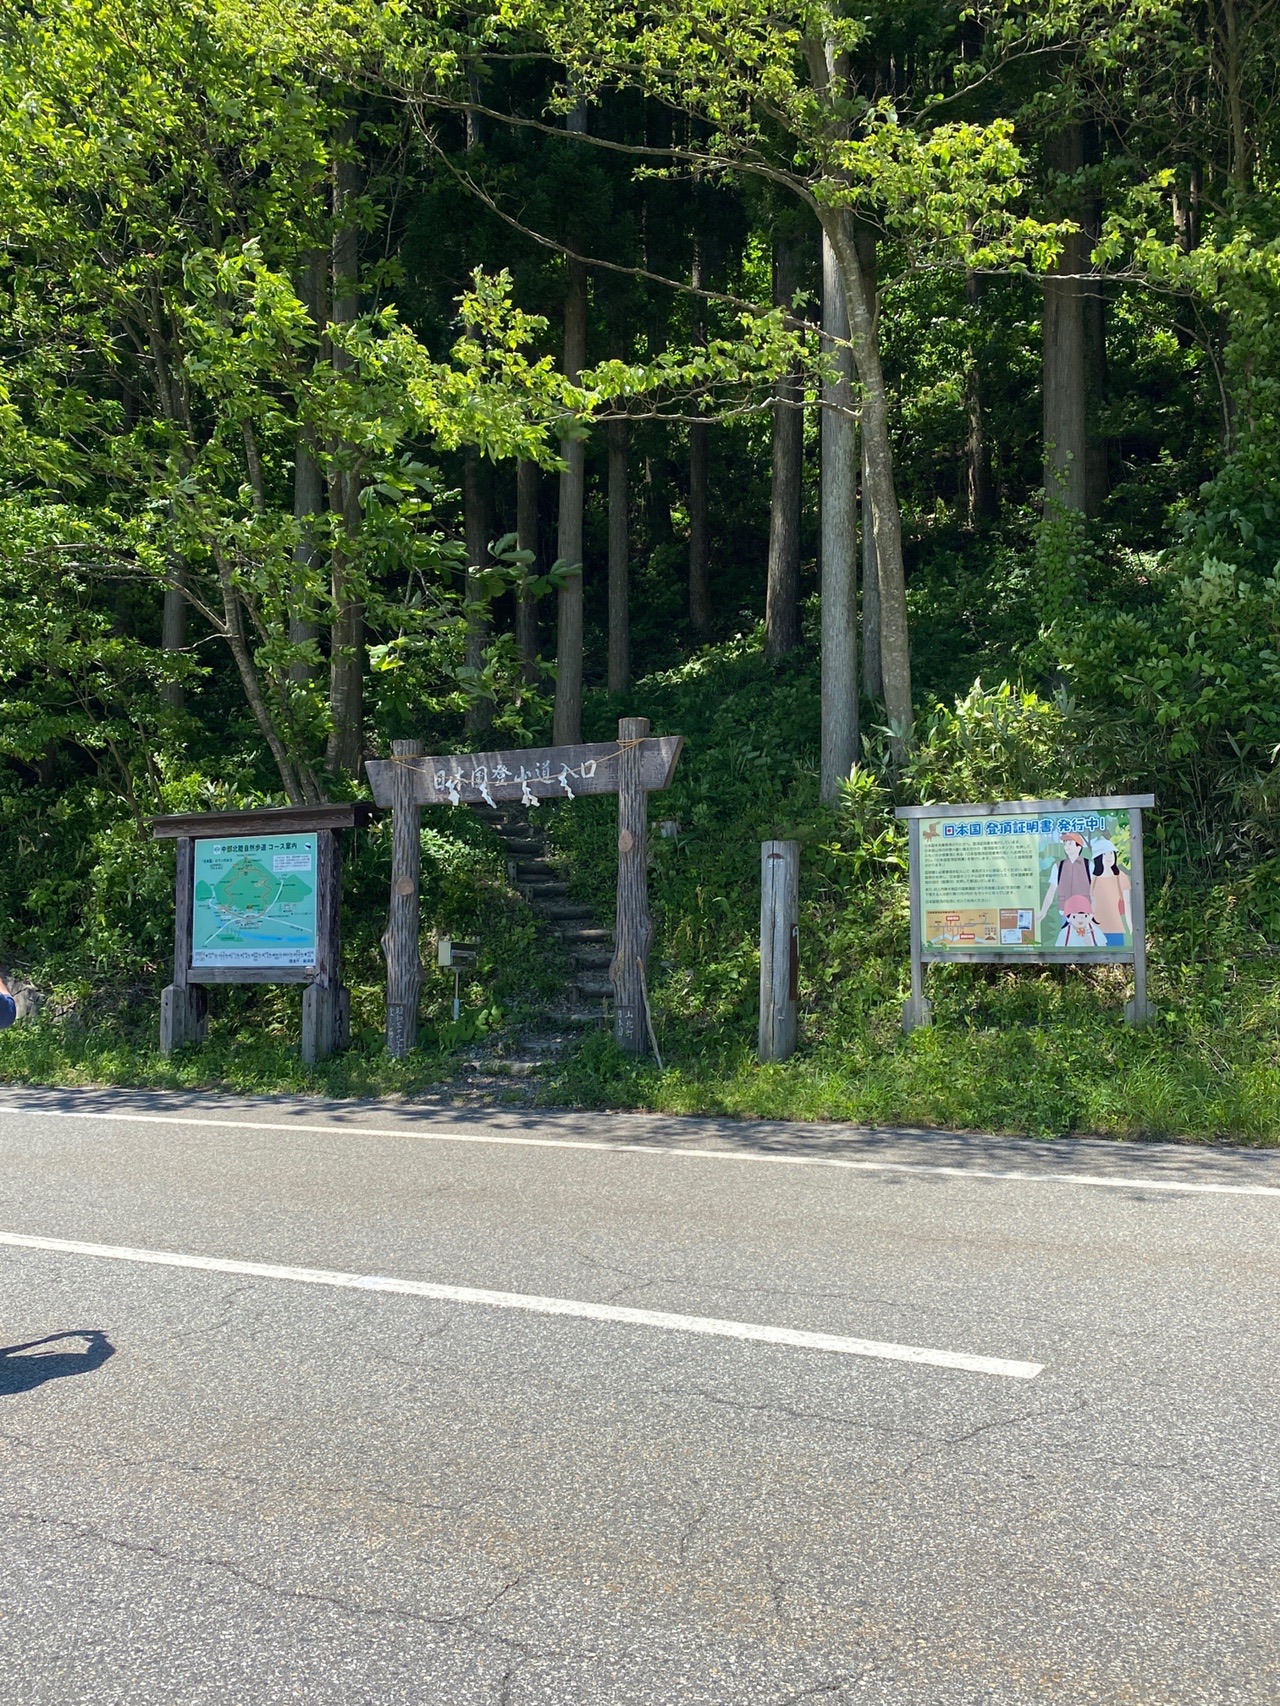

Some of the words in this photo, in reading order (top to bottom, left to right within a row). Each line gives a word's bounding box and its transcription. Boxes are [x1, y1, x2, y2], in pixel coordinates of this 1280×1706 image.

[943, 822, 982, 838] 日本国
[985, 819, 1053, 836] 登頂証明書
[221, 843, 267, 853] 中部北陸自然歩道
[268, 842, 298, 851] コース案内
